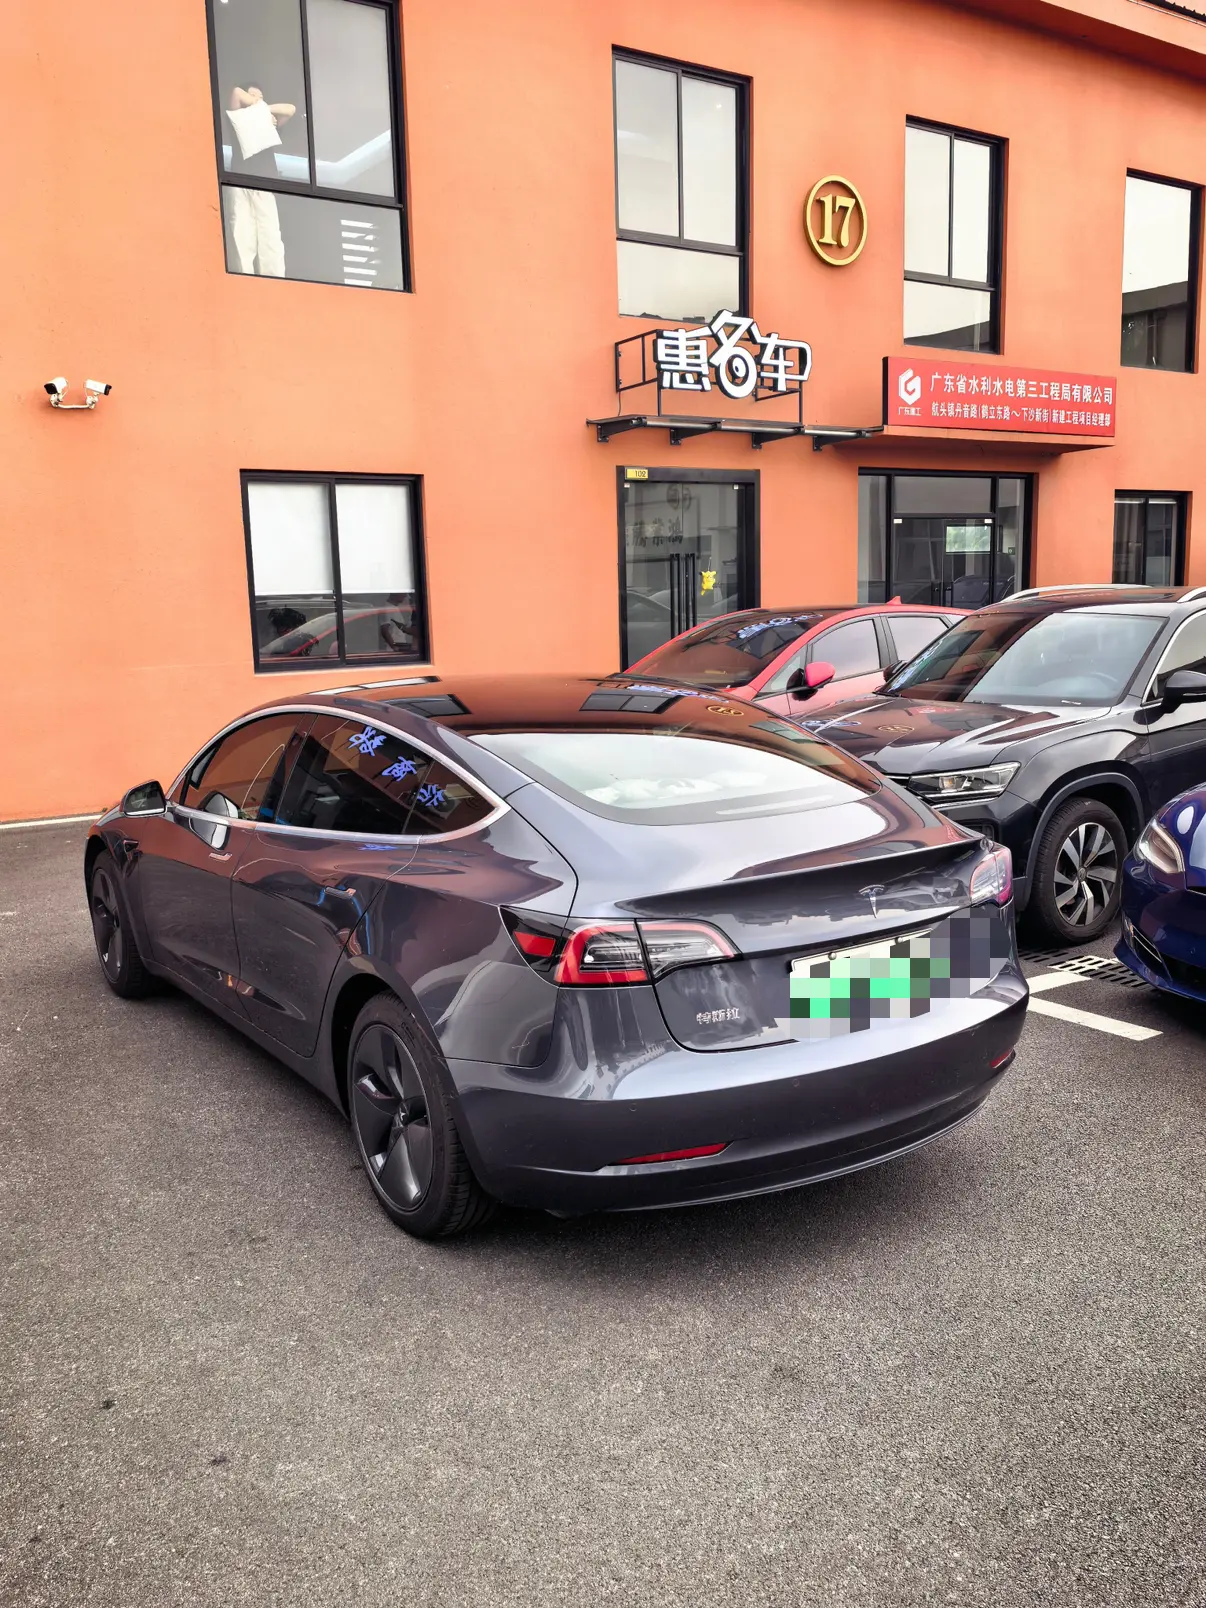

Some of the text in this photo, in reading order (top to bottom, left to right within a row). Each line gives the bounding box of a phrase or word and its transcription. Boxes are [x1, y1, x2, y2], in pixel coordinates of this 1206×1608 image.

[816, 193, 856, 248] 17
[654, 309, 812, 400] 惠名车
[930, 371, 1113, 406] 广东省水利水电第三工程局有限公司
[634, 470, 647, 478] 102
[696, 1007, 740, 1025] 特斯拉
